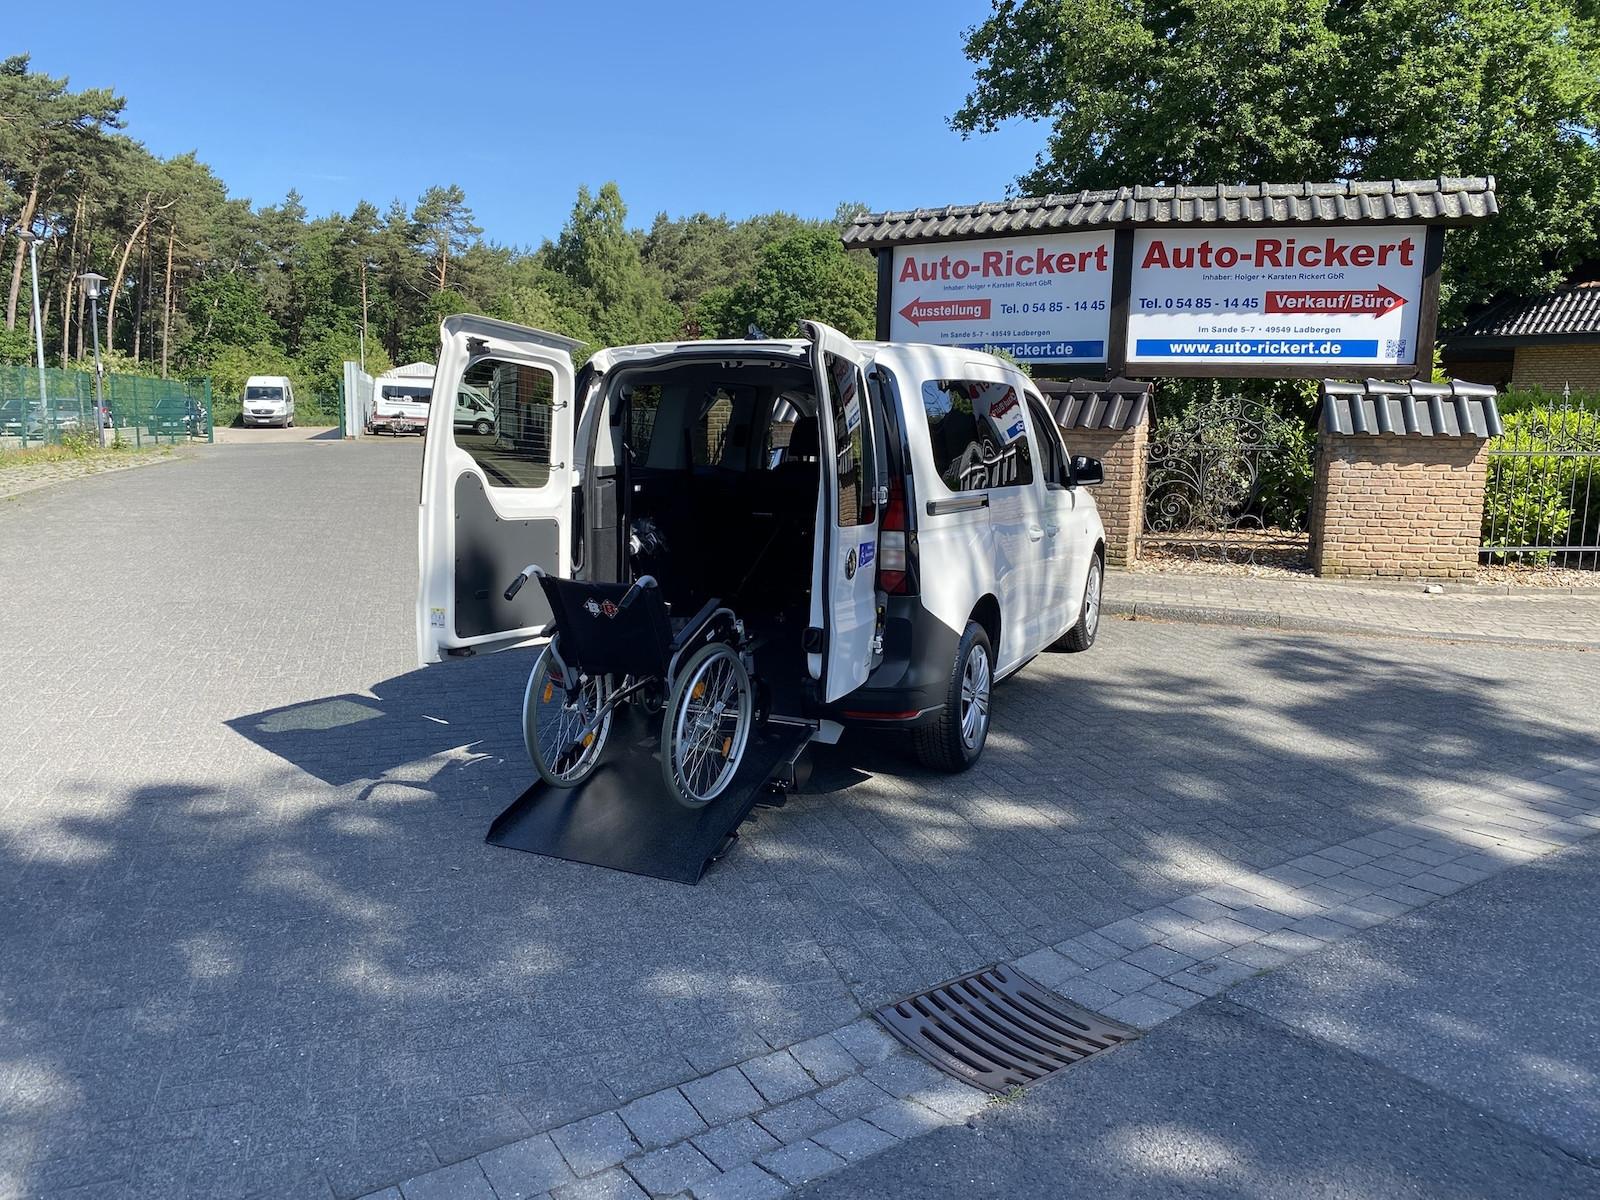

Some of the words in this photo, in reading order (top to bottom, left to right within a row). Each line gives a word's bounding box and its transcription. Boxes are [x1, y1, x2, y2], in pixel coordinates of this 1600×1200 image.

[1141, 237, 1415, 269] Auto-Rickert
[899, 244, 1108, 282] Auto-Rickert
[1000, 304, 1019, 314] Tel.
[1022, 303, 1029, 313] 0
[1032, 303, 1046, 312] 54
[1049, 302, 1063, 312] 85
[1074, 301, 1088, 311] 14
[1091, 300, 1105, 310] 45
[1139, 298, 1162, 308] Tel.
[1165, 298, 1173, 308] 0
[1176, 298, 1192, 308] 54
[1195, 298, 1212, 308] 85
[1223, 298, 1239, 308] 14
[1242, 298, 1259, 308] 45
[1276, 293, 1395, 309] Verkauf/Büro
[911, 304, 982, 318] Ausstellung
[1013, 329, 1051, 337] Ladbergen
[1294, 326, 1341, 334] Ladbergen
[1169, 340, 1342, 355] www.auto-rickert.de
